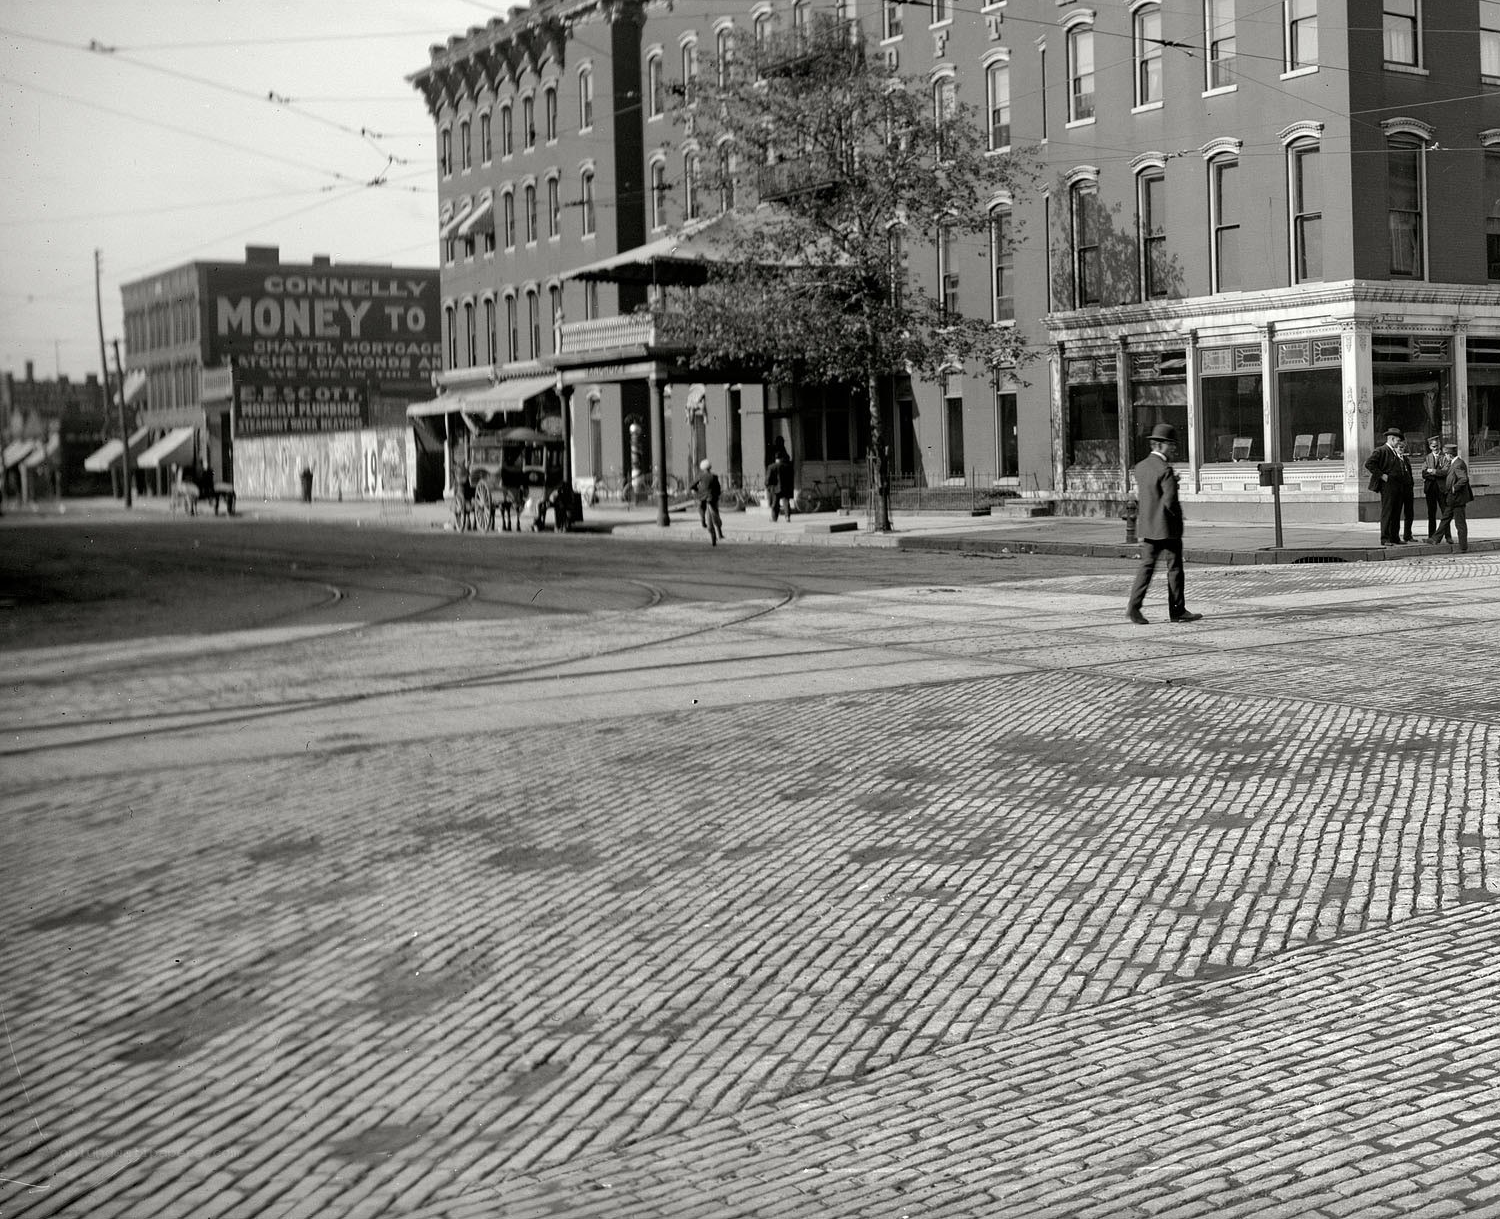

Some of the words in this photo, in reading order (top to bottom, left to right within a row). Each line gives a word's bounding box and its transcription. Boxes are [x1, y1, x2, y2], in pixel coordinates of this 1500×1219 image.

[263, 275, 427, 298] CONNELLY
[216, 295, 372, 338] MONEY
[384, 306, 426, 332] TO
[253, 340, 337, 355] CHATTEL
[316, 355, 411, 370] DIAMONDS
